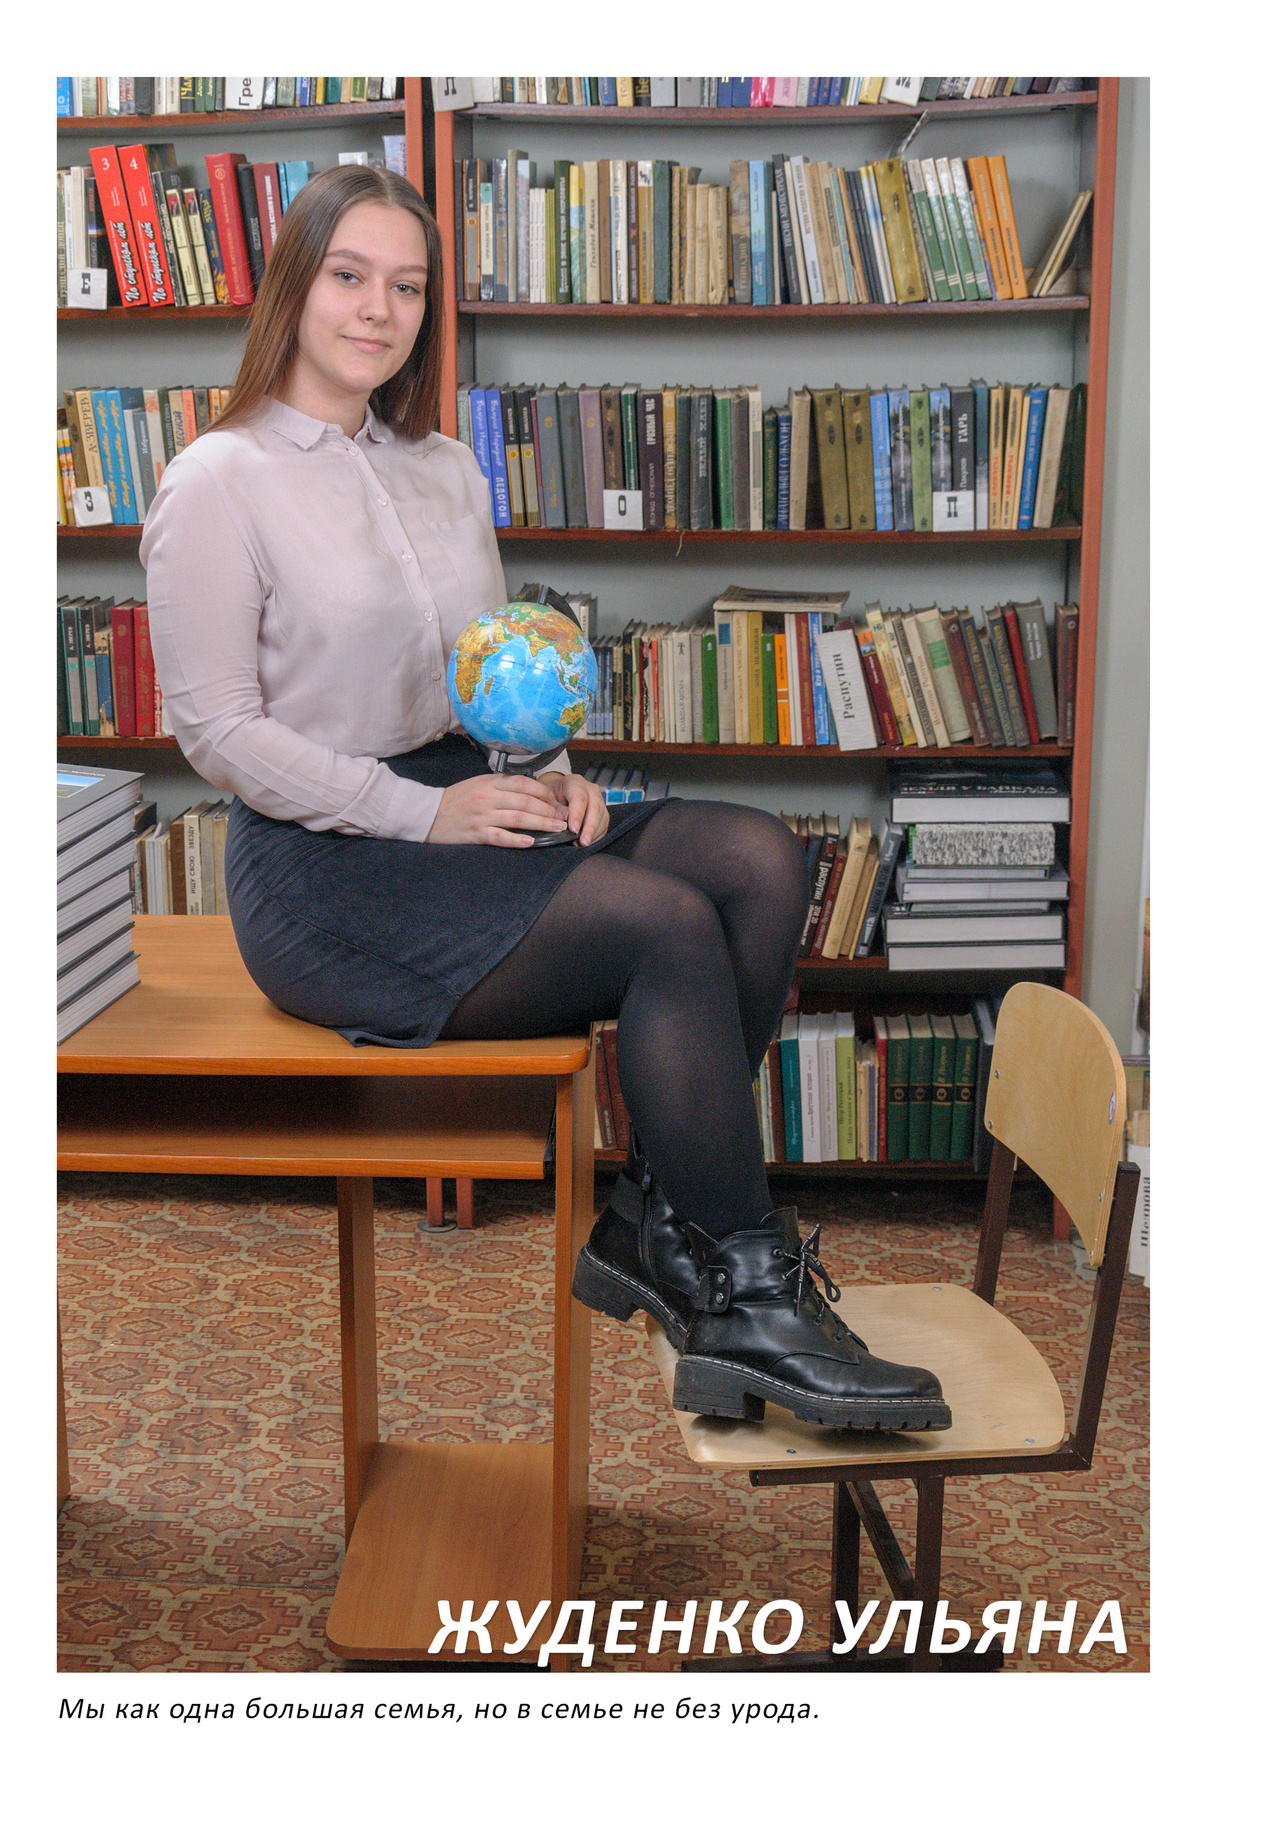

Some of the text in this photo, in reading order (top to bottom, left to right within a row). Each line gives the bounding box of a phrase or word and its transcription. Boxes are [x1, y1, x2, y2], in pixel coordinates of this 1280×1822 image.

[101, 157, 110, 170] 3
[129, 157, 138, 170] 4
[775, 168, 792, 247] ПЕСНИ МЕНЕСТРЕЛЯ
[112, 221, 126, 240] лет
[141, 221, 154, 240] лет
[81, 272, 91, 295] Е
[124, 286, 140, 302] По
[151, 286, 167, 302] По
[645, 398, 655, 412] ЧАС
[138, 421, 149, 454] Избранное
[173, 411, 185, 447] ВЕСНОЙ
[645, 414, 656, 445] ГРОЗНЫЙ
[698, 398, 707, 477] БЕЛЫЙ ХЛЕБ
[958, 413, 969, 443] ГАРЬ
[83, 490, 94, 512] З
[496, 477, 508, 518] ЛЕДОГОН
[833, 653, 855, 719] Распутин
[187, 825, 195, 849] ЗВЕЗДУ
